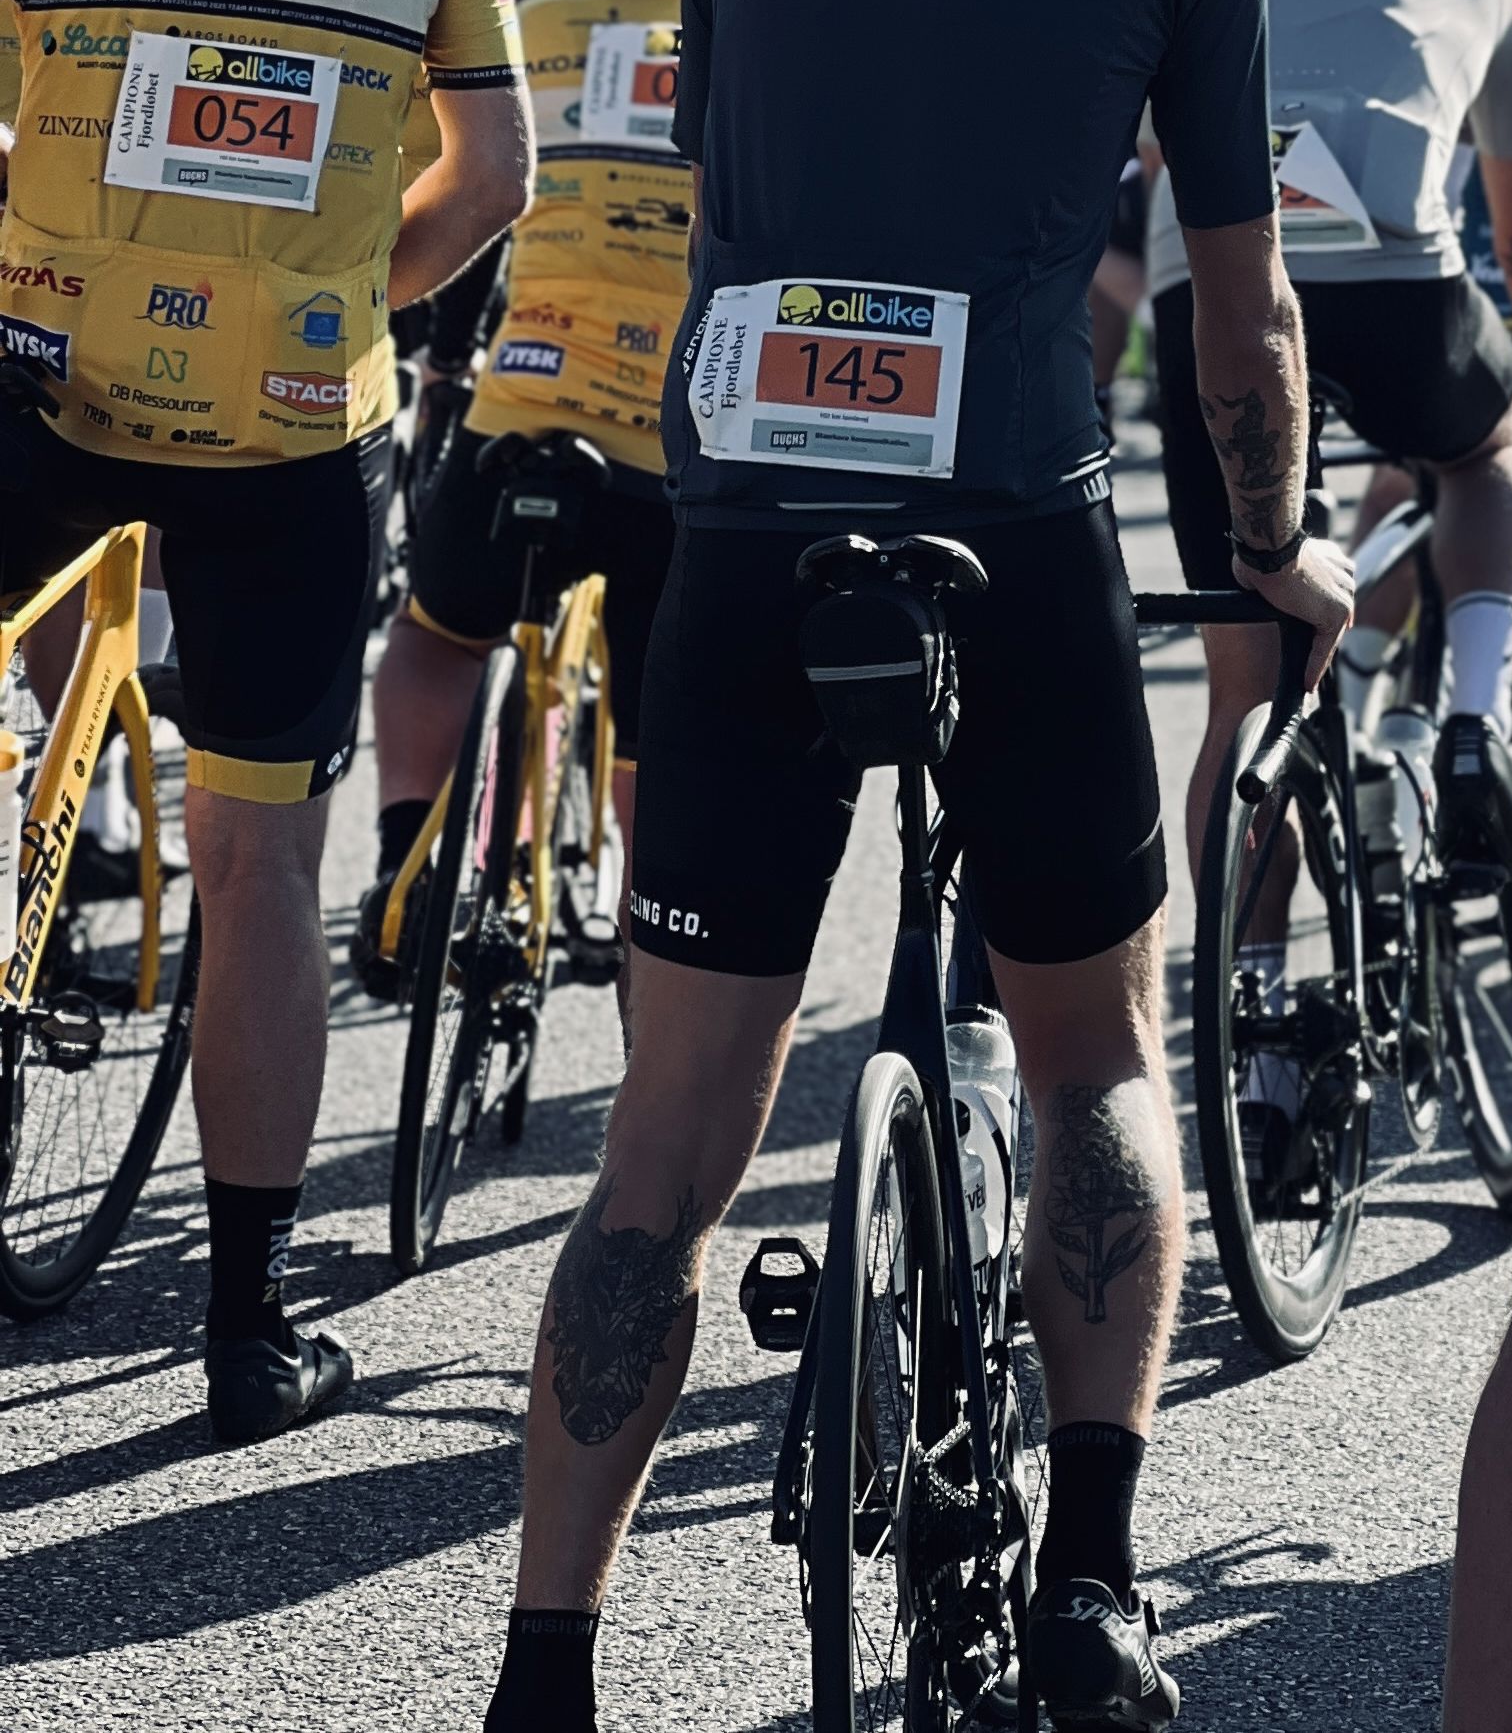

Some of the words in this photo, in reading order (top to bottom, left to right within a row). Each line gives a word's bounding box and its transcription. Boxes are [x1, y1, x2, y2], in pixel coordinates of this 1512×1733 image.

[60, 23, 130, 56] Leca
[228, 31, 278, 49] BOARD
[227, 55, 313, 89] allbike
[117, 62, 144, 154] CAMPIONE
[136, 71, 160, 149] Fjordløbet
[193, 95, 295, 151] 054
[178, 169, 208, 182] BUCHS
[146, 287, 208, 328] PRO
[827, 292, 933, 329] allbike
[6, 327, 62, 369] JYSK
[616, 322, 659, 354] PRO
[504, 347, 560, 369] JYSK
[699, 317, 729, 419] CAMPIONE
[721, 323, 747, 410] Fjordløbet
[800, 342, 906, 405] 145
[109, 384, 130, 401] DB
[132, 389, 215, 414] Ressourcer
[266, 375, 354, 405] STACO
[773, 432, 805, 446] BUCHS
[80, 721, 98, 757] TEAM
[92, 665, 113, 722] RYNKEBY
[4, 789, 77, 1002] Bianchi
[668, 908, 709, 939] CO.
